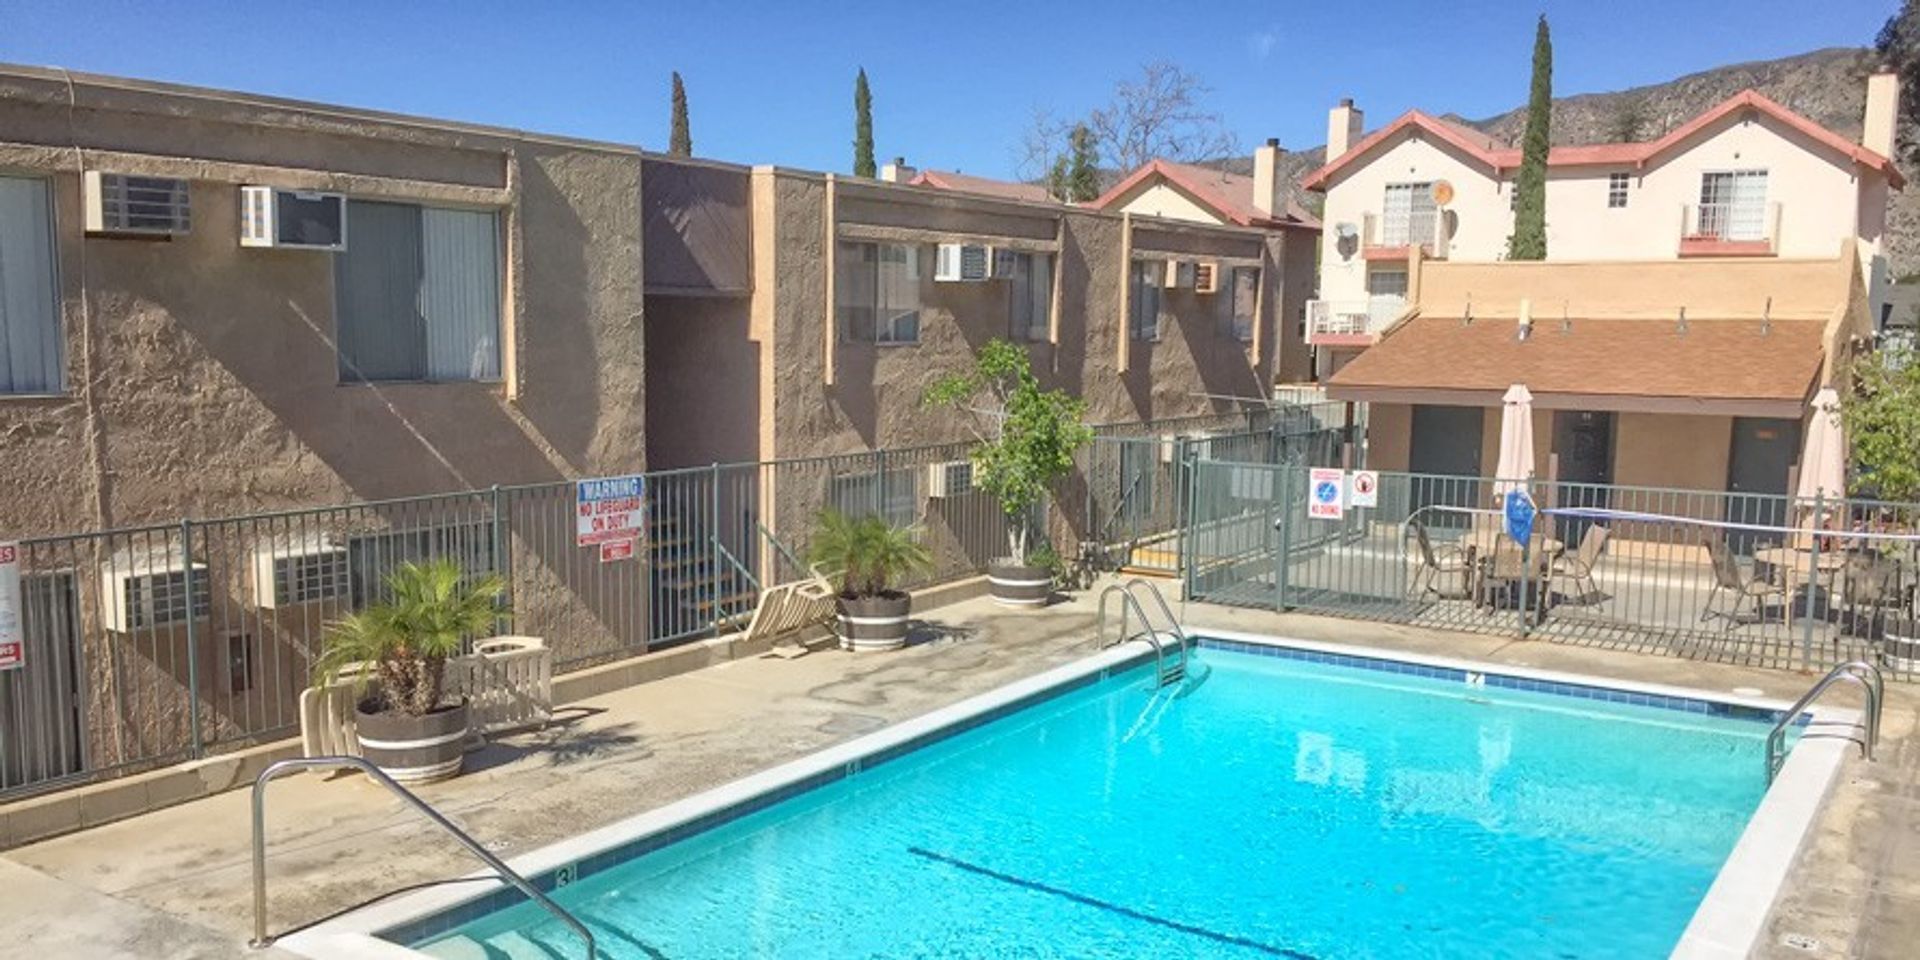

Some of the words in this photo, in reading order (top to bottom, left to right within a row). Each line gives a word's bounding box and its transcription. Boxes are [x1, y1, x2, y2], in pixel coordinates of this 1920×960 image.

[584, 478, 639, 499] WARNING
[580, 502, 592, 516] NO
[596, 497, 640, 515] LIFEGUARD
[1311, 504, 1319, 514] NO
[592, 517, 605, 531] ON
[608, 513, 630, 530] DUTY
[1470, 671, 1481, 684] 7
